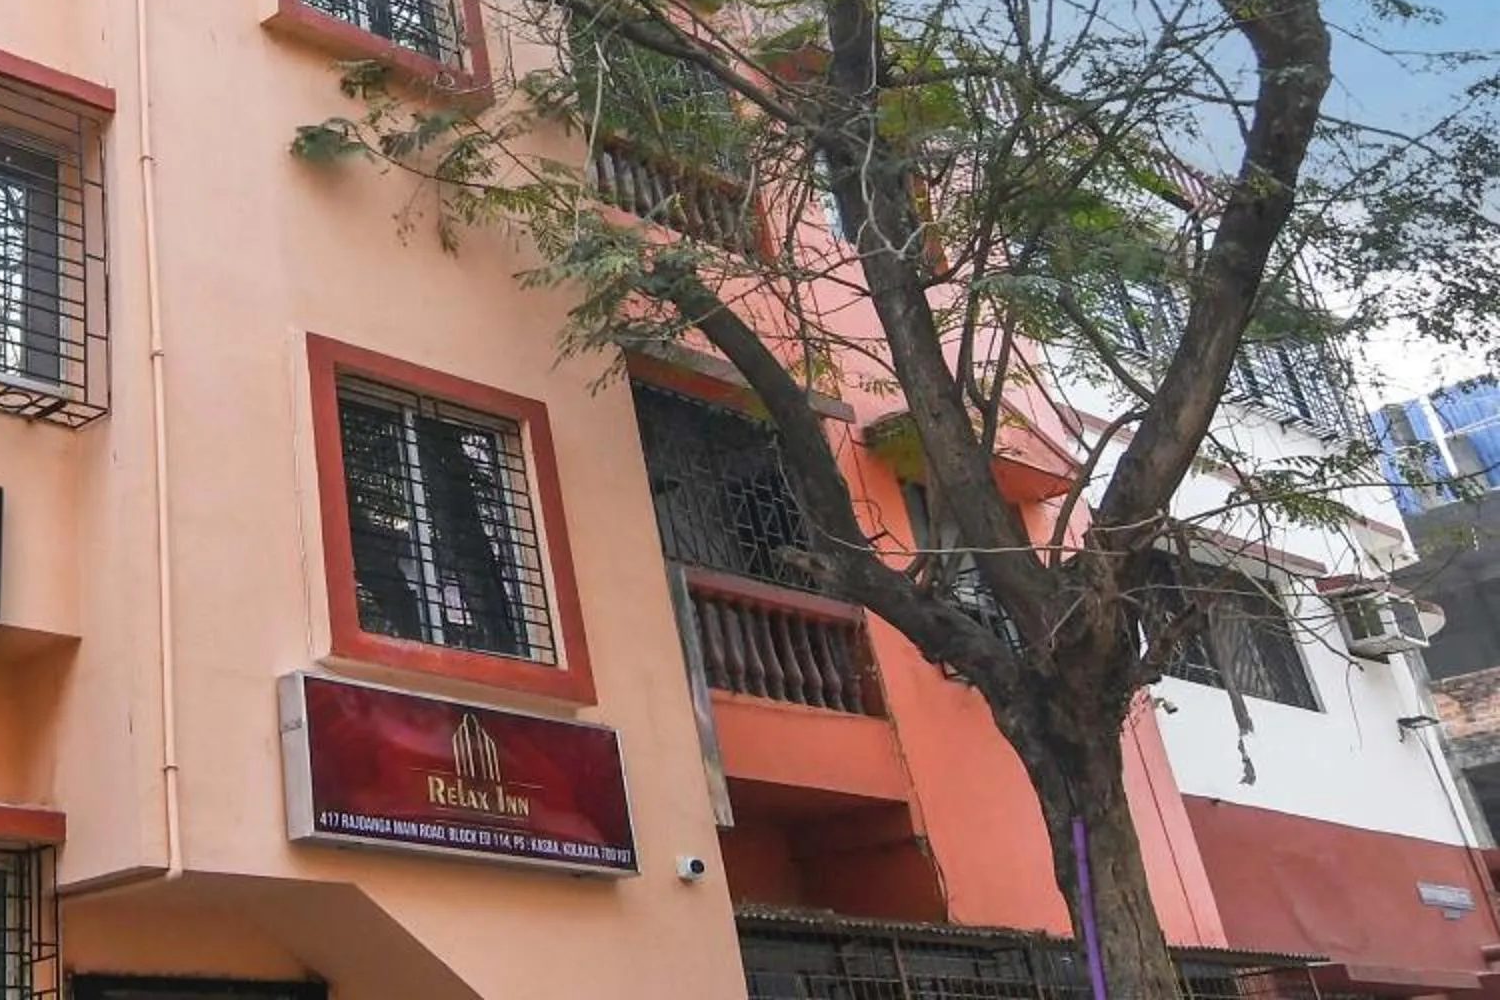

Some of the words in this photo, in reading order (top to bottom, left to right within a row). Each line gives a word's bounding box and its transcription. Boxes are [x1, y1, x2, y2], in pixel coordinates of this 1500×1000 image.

[319, 811, 339, 828] 417
[341, 813, 393, 834] RAJDANGA
[394, 819, 418, 837] MAIN
[448, 827, 477, 844] BLOCK
[479, 831, 491, 845] ED
[513, 834, 525, 851] PS
